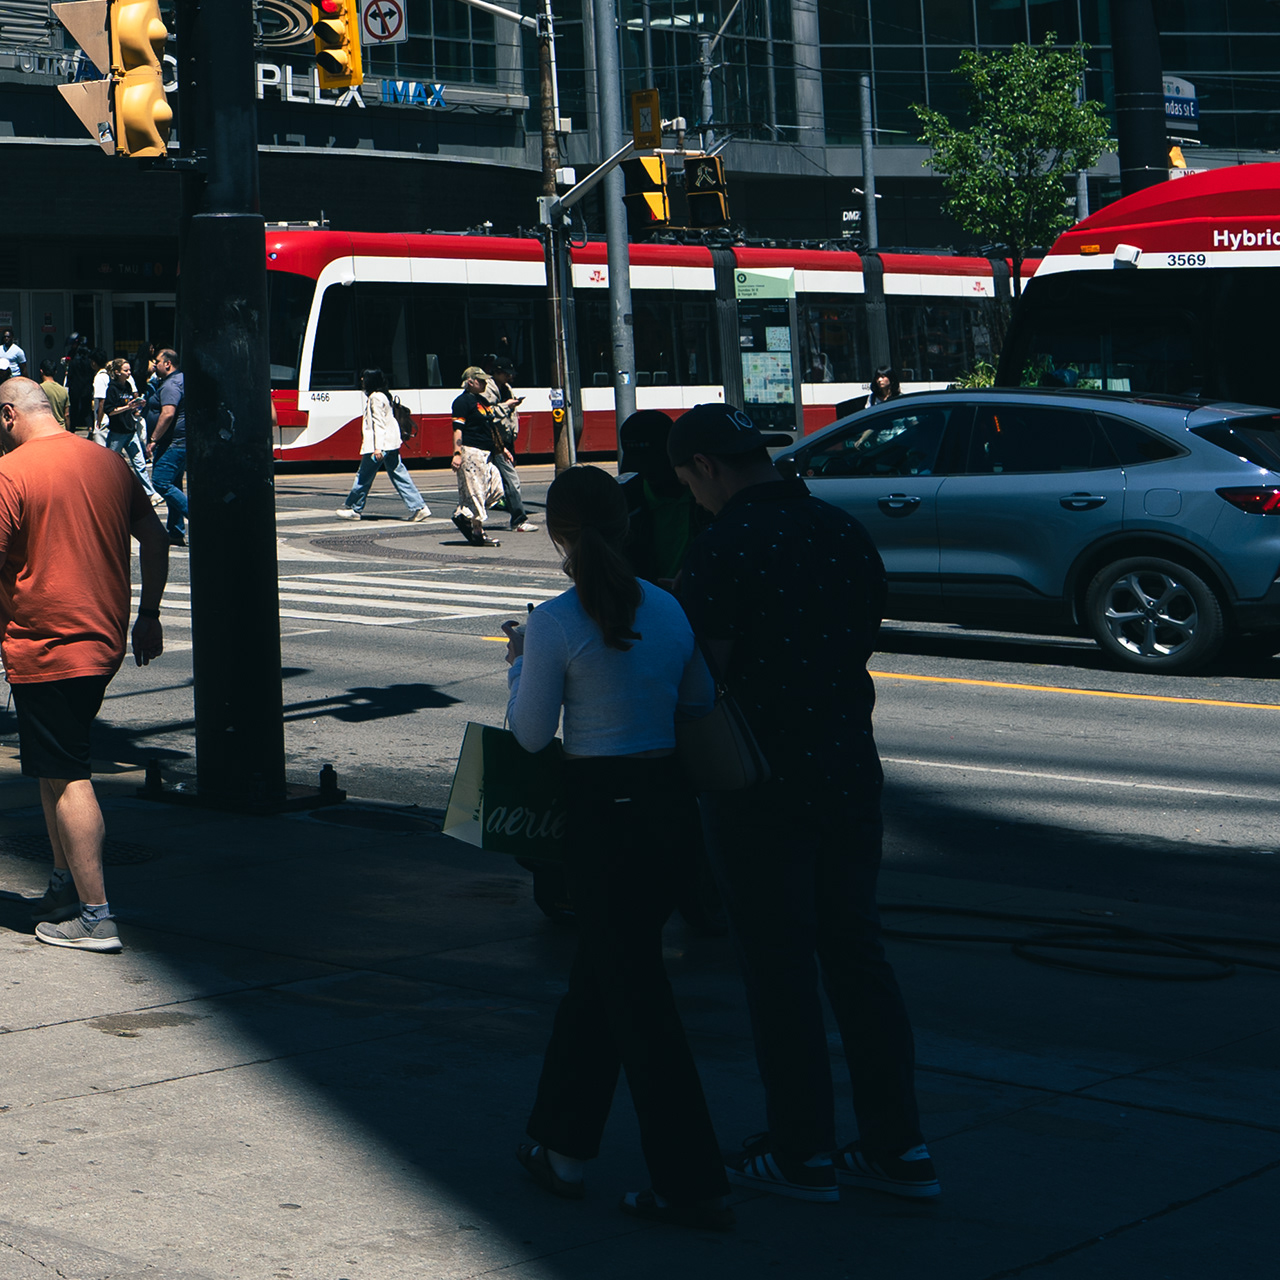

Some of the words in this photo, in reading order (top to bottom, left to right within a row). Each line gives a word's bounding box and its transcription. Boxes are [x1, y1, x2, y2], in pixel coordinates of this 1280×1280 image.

[381, 80, 448, 108] IMAX
[1165, 100, 1183, 117] ndas
[1167, 254, 1206, 267] 3569
[310, 392, 330, 402] 4466
